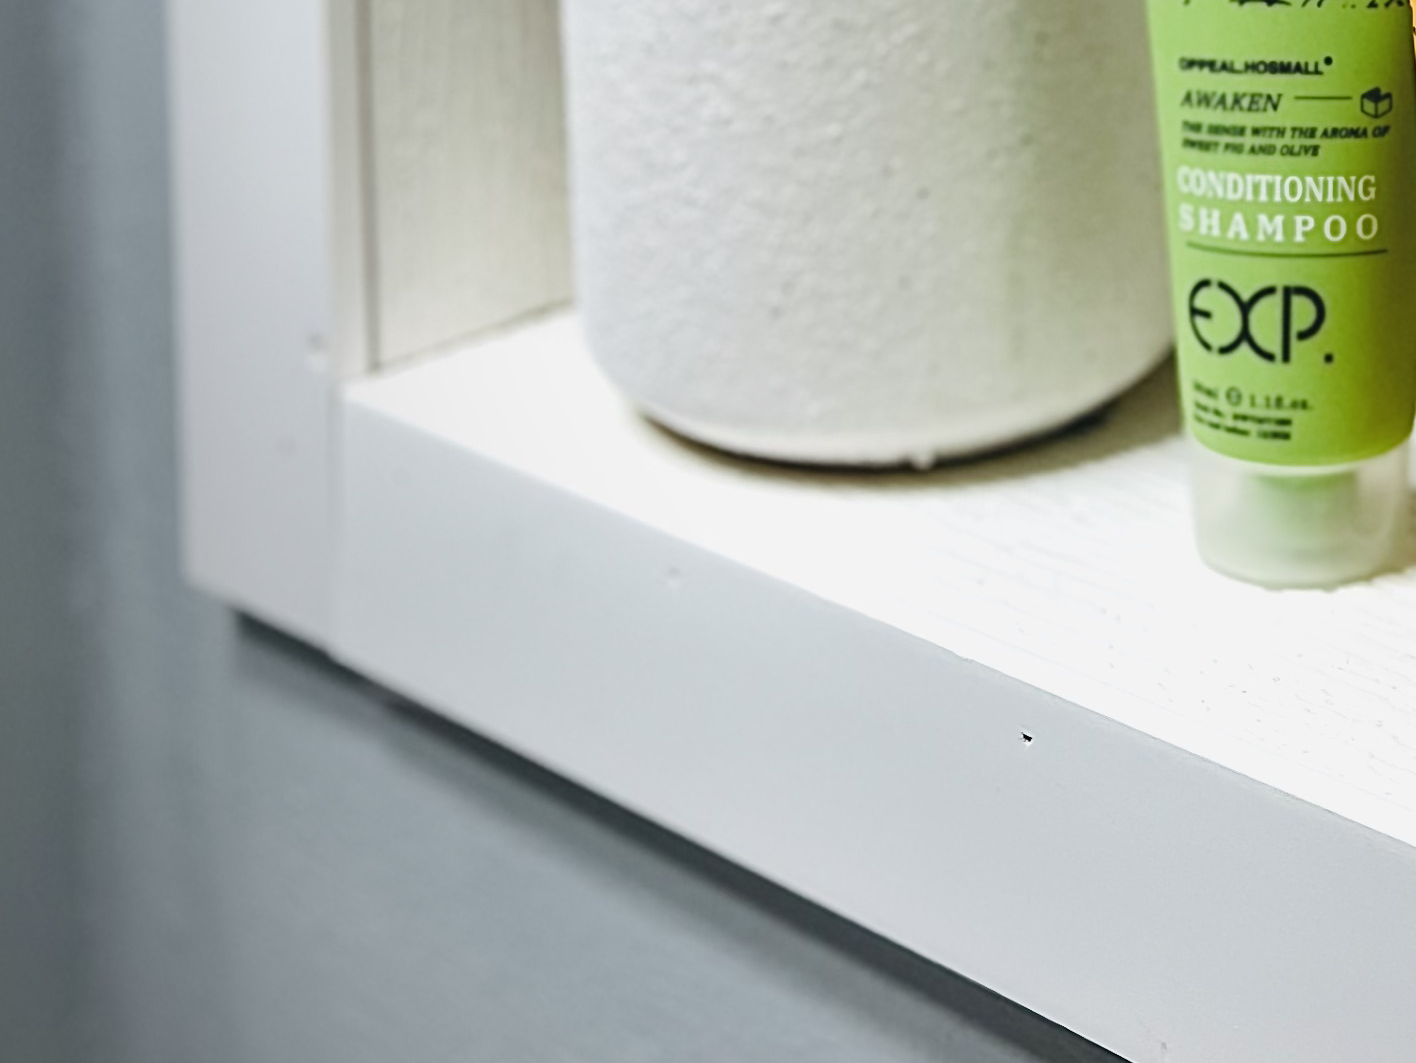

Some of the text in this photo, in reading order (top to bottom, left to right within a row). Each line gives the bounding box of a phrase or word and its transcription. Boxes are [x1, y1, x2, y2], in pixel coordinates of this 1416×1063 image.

[1180, 90, 1283, 113] AWAKEN
[1250, 126, 1286, 138] WITH
[1290, 126, 1317, 139] THE
[1320, 127, 1368, 139] AROMA
[1372, 125, 1391, 137] OF
[1249, 144, 1276, 156] AND
[1279, 144, 1321, 157] OLIVE
[1176, 165, 1378, 203] CONDITIONING
[1178, 203, 1380, 243] SHAMPOO
